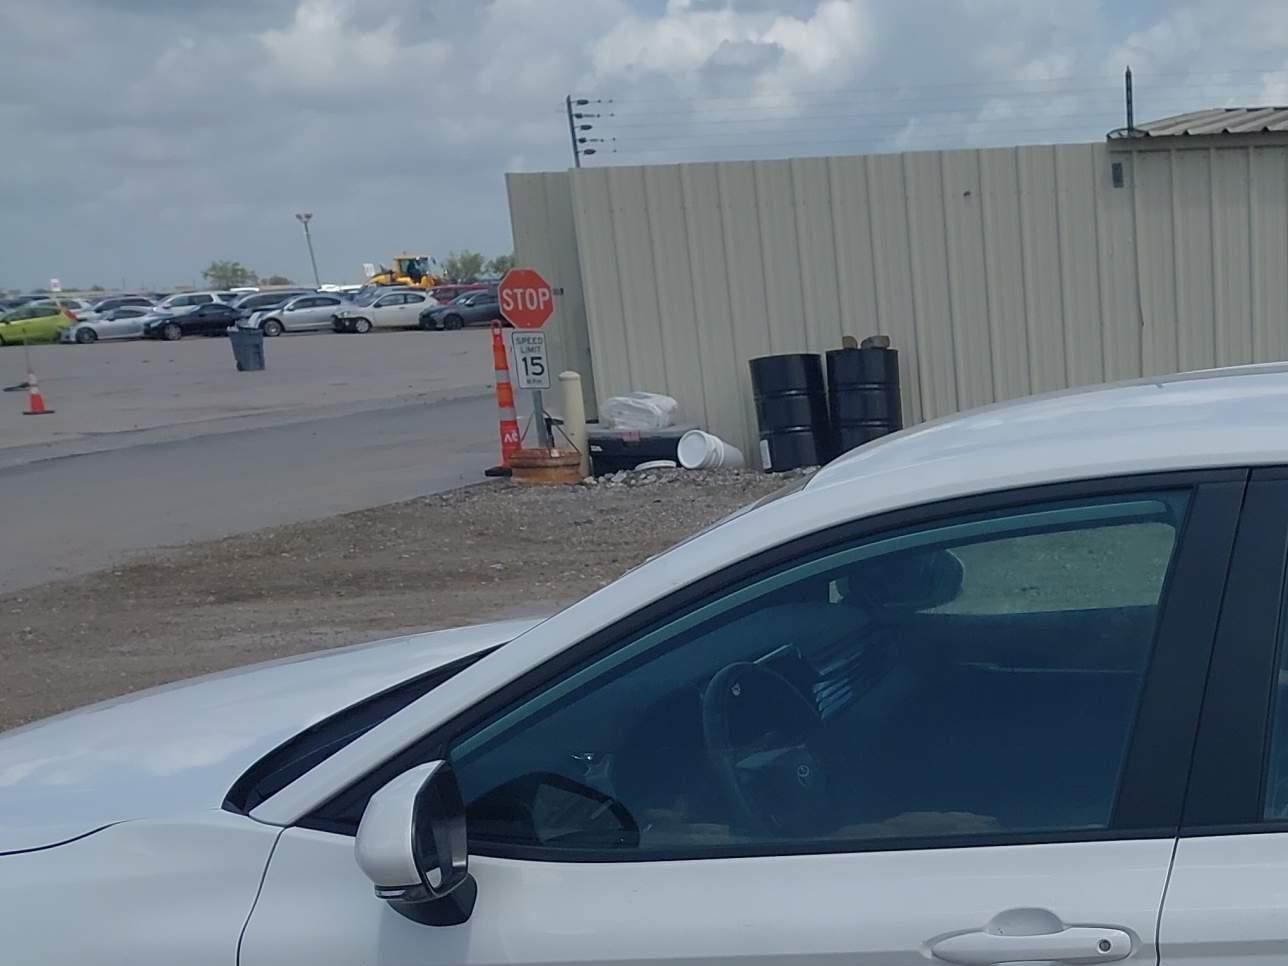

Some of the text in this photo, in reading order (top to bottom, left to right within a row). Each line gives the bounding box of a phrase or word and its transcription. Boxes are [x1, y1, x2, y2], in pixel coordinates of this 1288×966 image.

[502, 287, 550, 311] STOP
[515, 336, 543, 345] SPEED
[520, 345, 541, 354] LIMIT
[521, 356, 545, 376] 15
